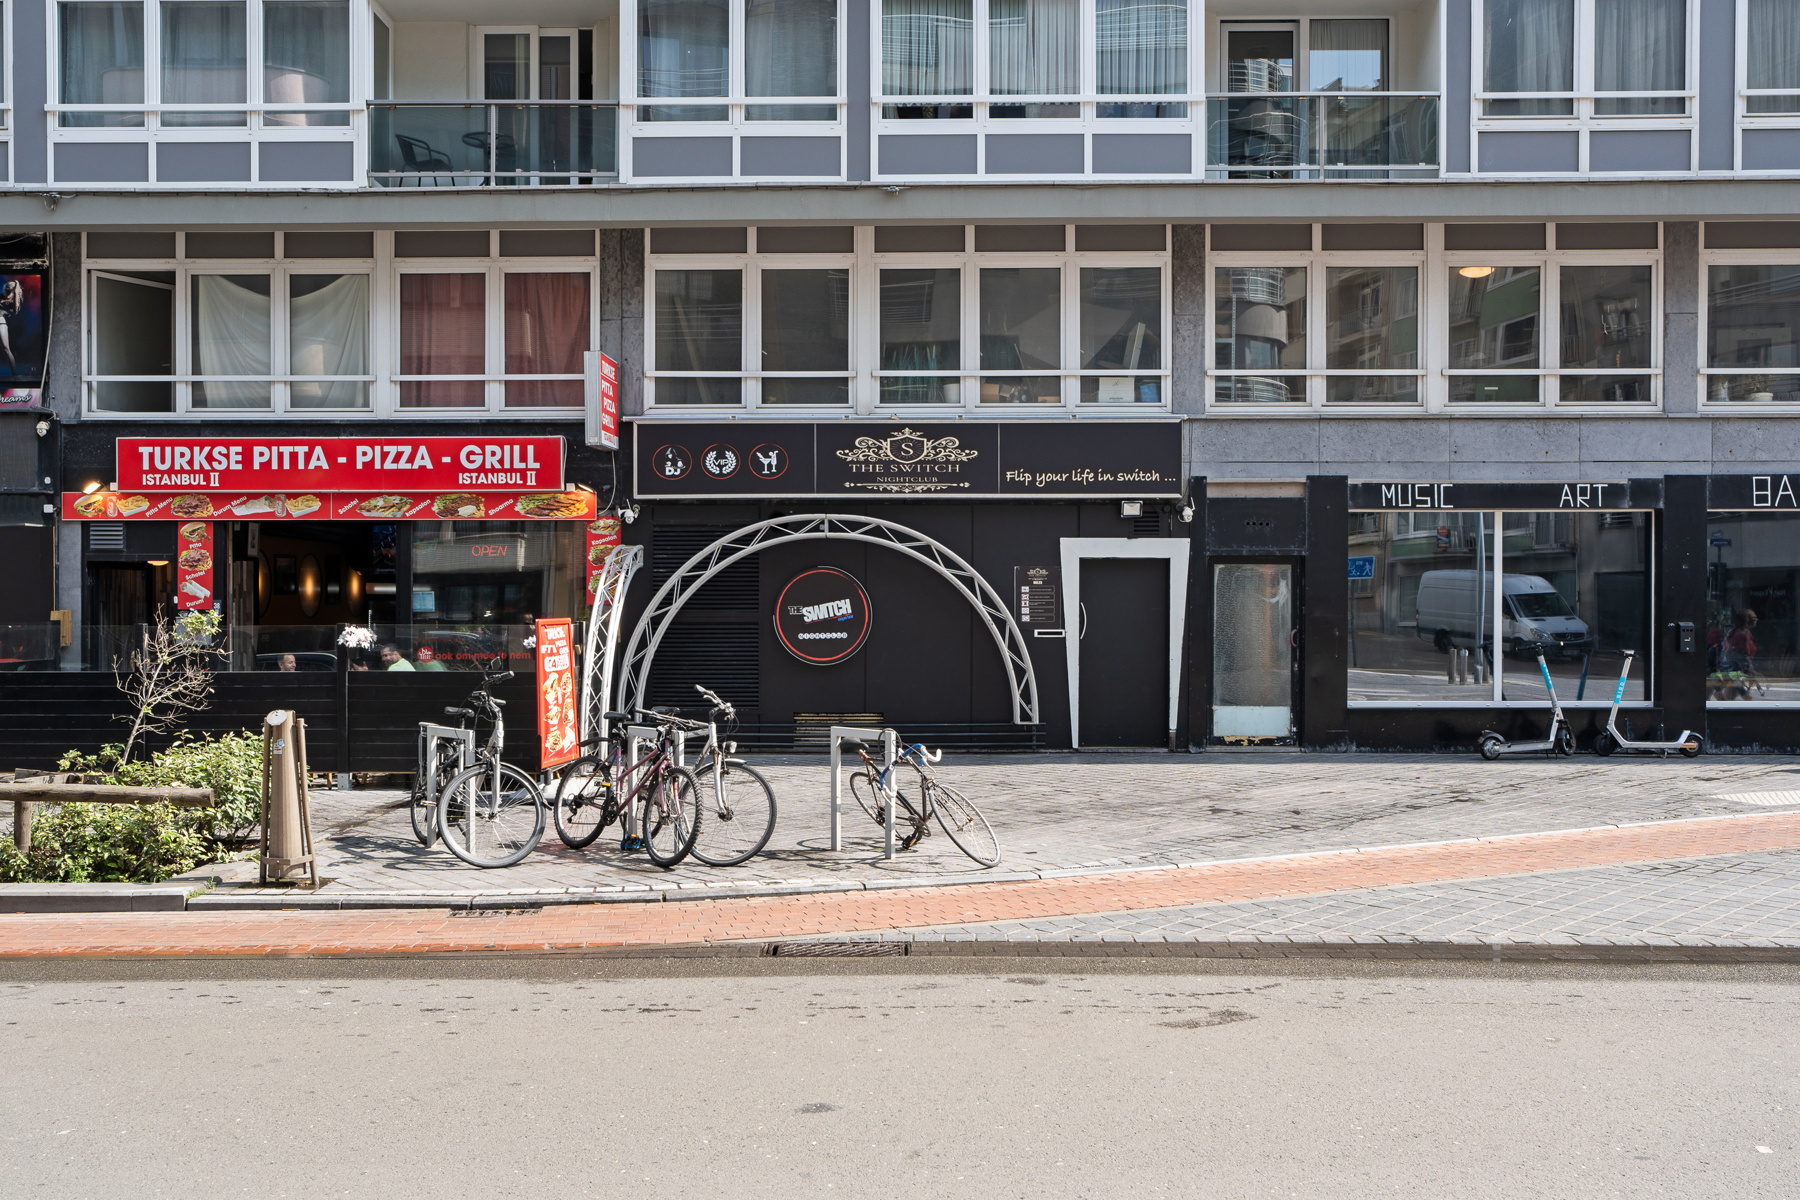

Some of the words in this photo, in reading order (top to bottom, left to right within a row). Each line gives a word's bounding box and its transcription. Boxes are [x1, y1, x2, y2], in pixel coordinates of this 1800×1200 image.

[602, 360, 615, 380] TURKSE
[602, 379, 614, 397] PITTA
[603, 396, 616, 414] PIZZA
[602, 412, 614, 429] GRILL
[139, 446, 243, 470] TURKSE
[253, 446, 330, 470] PITTA
[356, 446, 434, 470] PIZZA
[460, 445, 541, 470] GRILL
[901, 443, 914, 456] S
[665, 467, 681, 476] DJ
[849, 464, 884, 473] THE
[890, 463, 960, 473] SWITCH
[142, 474, 207, 486] ISTANBUL
[210, 472, 220, 487] II
[458, 473, 524, 485] ISTANBUL
[527, 471, 537, 486] II
[1006, 469, 1032, 486] Flip
[1036, 472, 1069, 487] your
[1072, 469, 1094, 486] life
[1098, 469, 1114, 482] in
[1117, 469, 1160, 482] switch
[1382, 484, 1454, 508] MUSIC
[1560, 484, 1608, 508] ART
[145, 507, 158, 518] Pitta
[157, 497, 173, 509] Menu
[213, 504, 232, 517] Durum
[231, 496, 247, 507] Menu
[338, 498, 359, 515] Schotel
[488, 499, 514, 516] Shoarma
[591, 535, 617, 546] Kapsalon
[472, 545, 508, 557] OPEN
[185, 571, 205, 580] Schotel
[788, 606, 803, 615] THE
[802, 599, 852, 622] SWITCH
[436, 652, 454, 660] ook
